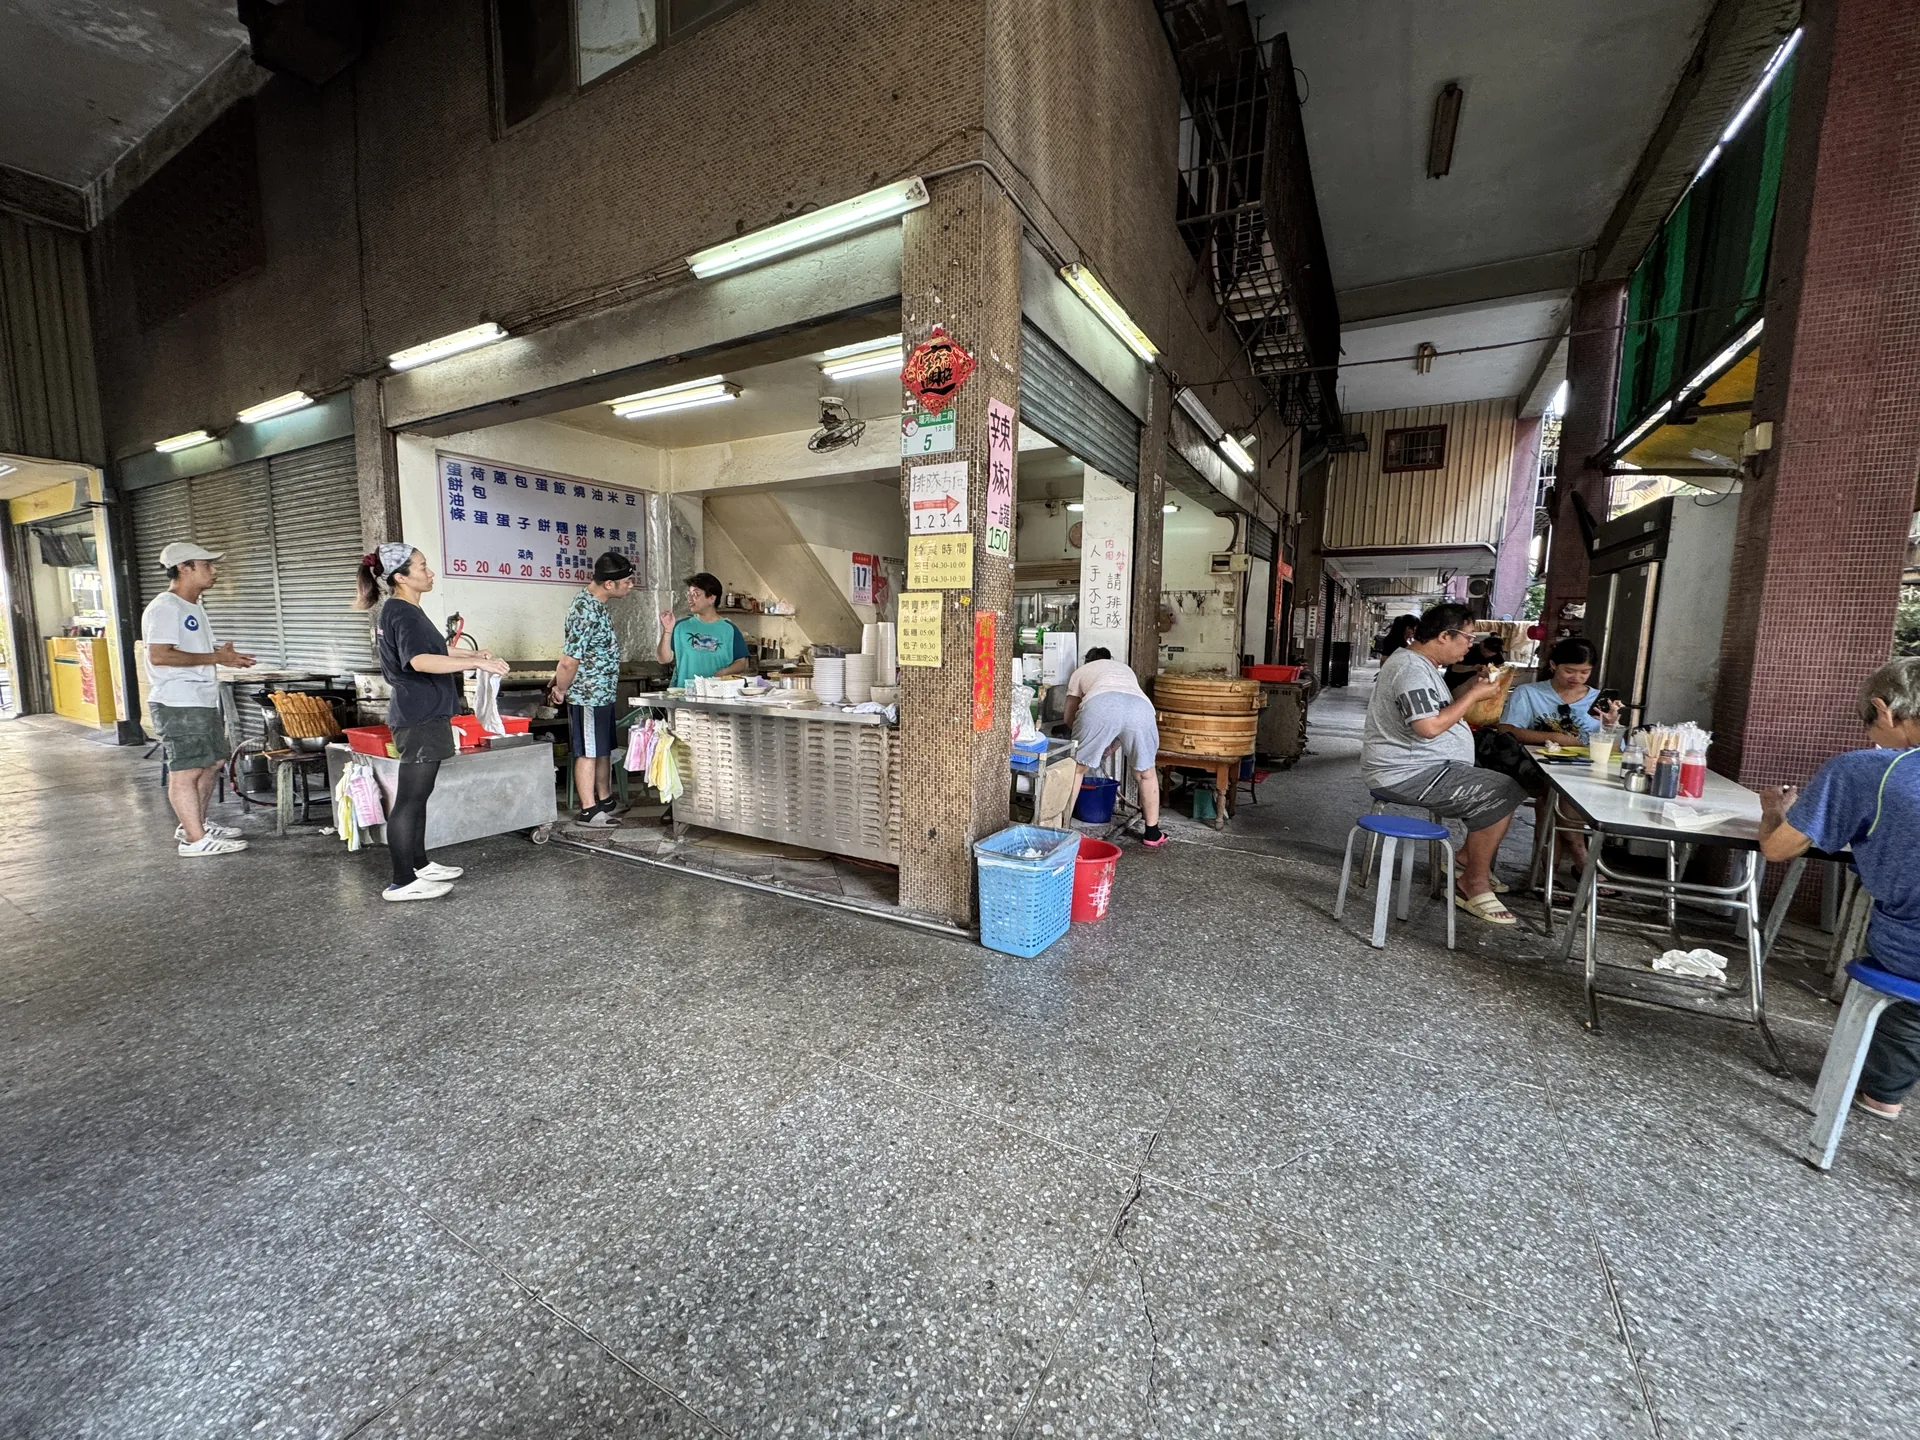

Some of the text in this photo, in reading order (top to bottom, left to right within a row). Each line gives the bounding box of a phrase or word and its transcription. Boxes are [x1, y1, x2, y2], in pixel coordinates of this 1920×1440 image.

[924, 434, 933, 451] 5
[990, 408, 1010, 498] 辣椒
[446, 461, 466, 522] 蛋餅油條
[470, 466, 489, 525] 荷包蛋
[514, 474, 531, 530] 包子
[535, 477, 551, 533] 蛋餅
[573, 485, 588, 537] 燒餅
[591, 488, 606, 539] 油條
[557, 534, 570, 546] 45
[576, 536, 587, 548] 20
[988, 526, 1009, 552] 150
[518, 549, 533, 560] 菜肉
[453, 559, 467, 572] 55
[476, 560, 489, 573] 20
[499, 562, 511, 575] 40
[520, 564, 532, 577] 20
[540, 566, 552, 578] 35
[558, 568, 571, 579] 65
[574, 569, 585, 581] 40
[857, 566, 867, 587] 17
[1089, 544, 1103, 626] 人手不足
[1105, 573, 1122, 628] 請排隊
[903, 641, 917, 650] 包子
